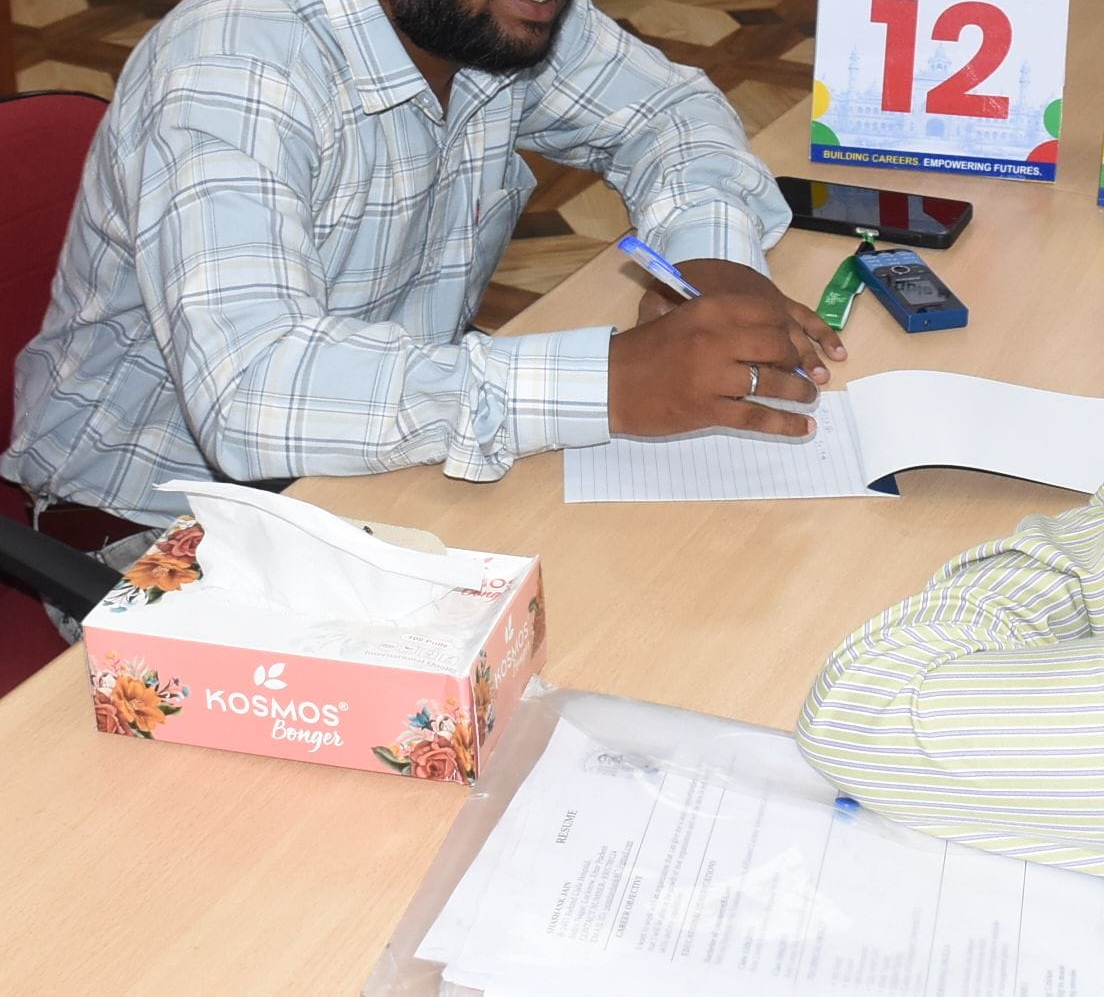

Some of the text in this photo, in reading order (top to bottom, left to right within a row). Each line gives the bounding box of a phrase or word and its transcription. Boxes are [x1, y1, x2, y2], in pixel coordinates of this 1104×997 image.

[823, 150, 869, 162] BUILDING
[923, 158, 992, 172] EMPOWERING
[993, 163, 1043, 176] FUTURES.
[271, 719, 344, 753] Bonger
[555, 810, 578, 844] RESUME
